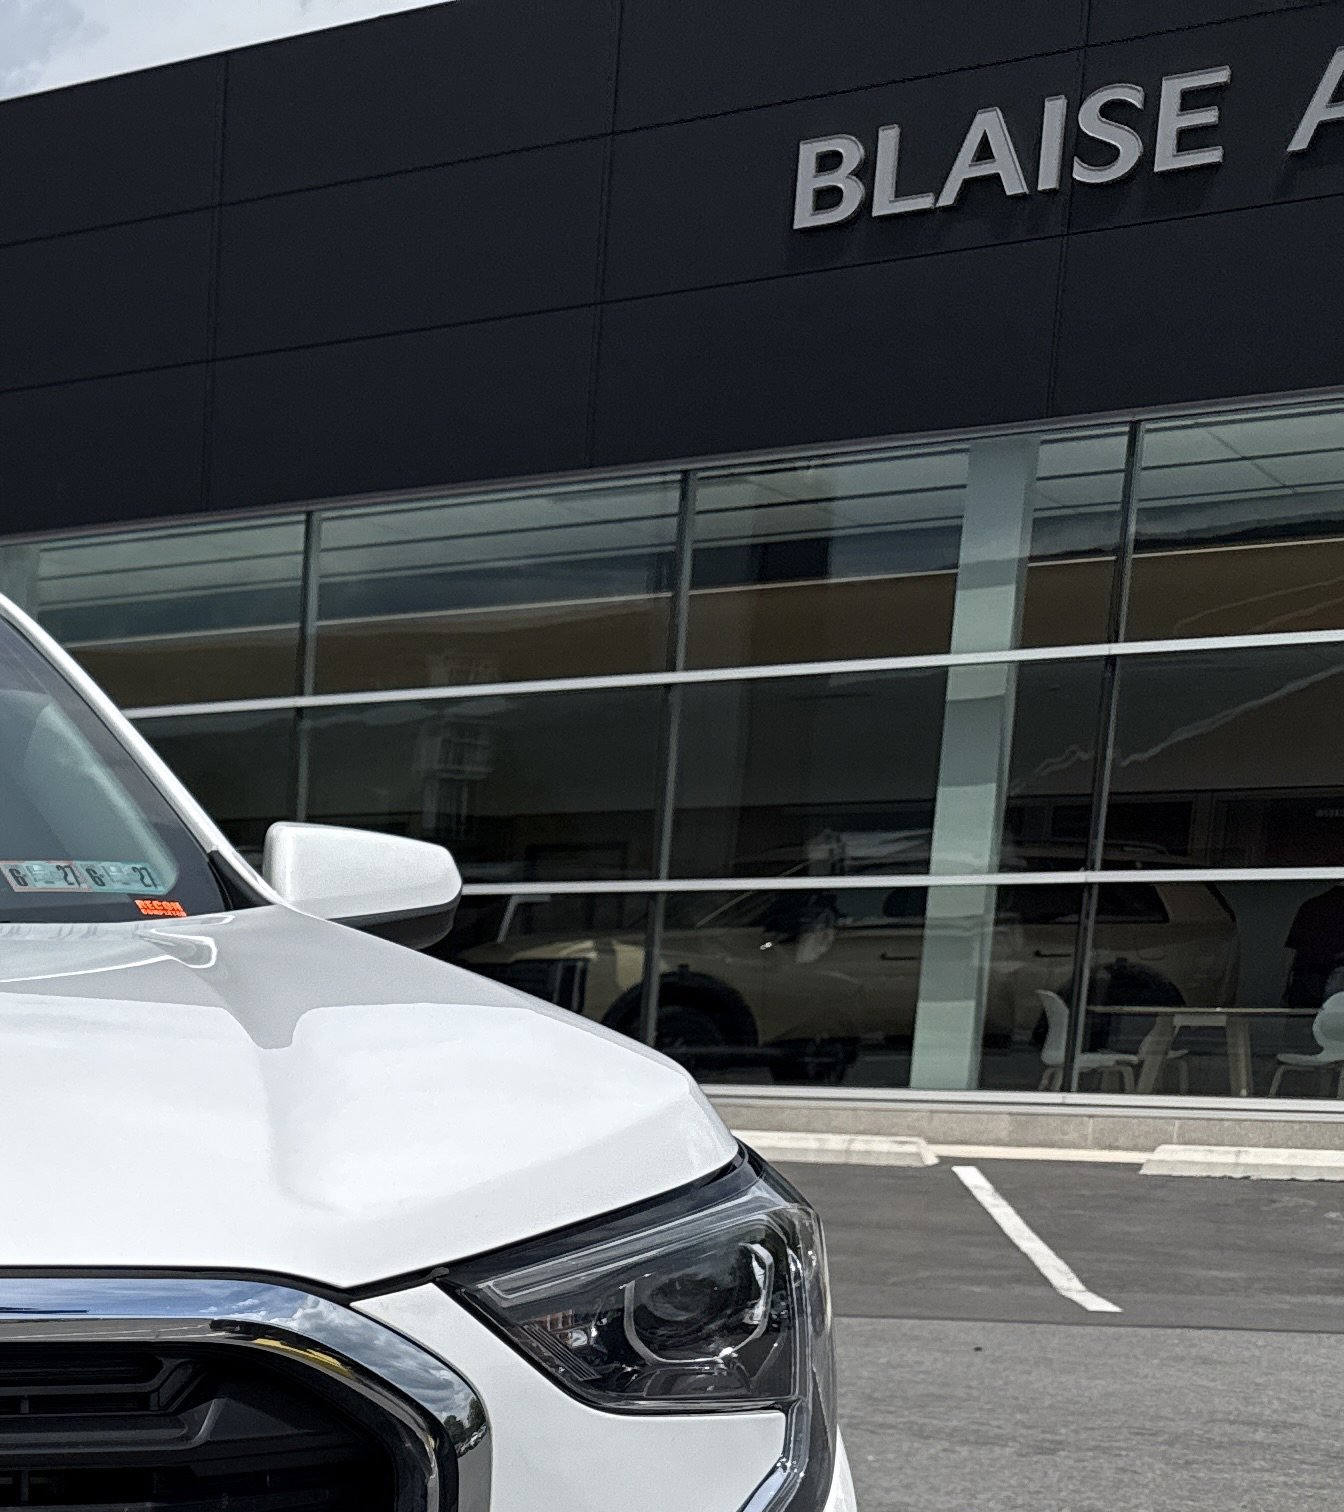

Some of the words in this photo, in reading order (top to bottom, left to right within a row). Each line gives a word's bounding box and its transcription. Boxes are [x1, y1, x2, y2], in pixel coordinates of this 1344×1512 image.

[792, 65, 1233, 231] BLAISE
[55, 864, 81, 888] 27
[131, 866, 159, 889] 27
